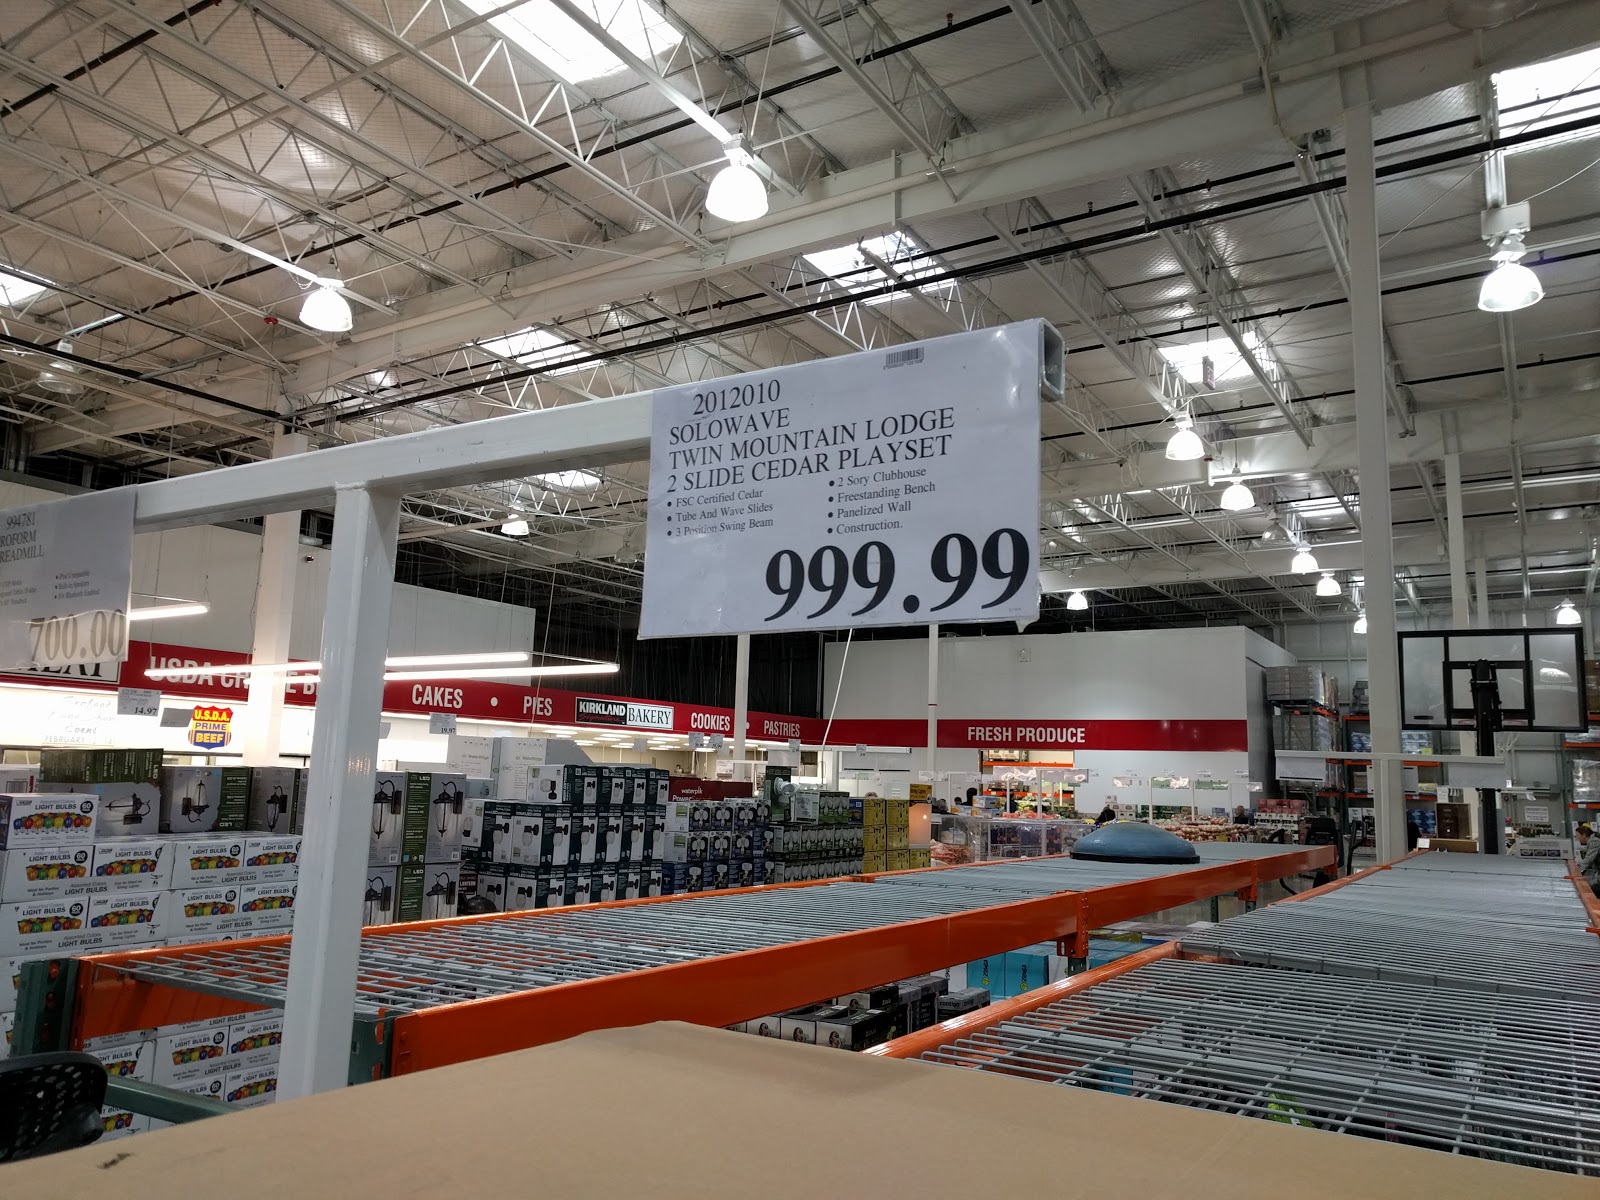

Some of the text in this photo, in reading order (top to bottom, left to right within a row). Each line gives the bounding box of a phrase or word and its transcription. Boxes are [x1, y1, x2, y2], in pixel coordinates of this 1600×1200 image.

[693, 379, 780, 415] 2012010
[669, 407, 790, 446] SOLOWAVE
[669, 407, 955, 470] TWIN MOUNTAIN LODGE
[667, 434, 952, 493] 2 SLIDE CEDAR PLAYSET
[838, 468, 927, 487] 2 Sory Clubhouse
[676, 489, 763, 507] FSC Certified Cedar
[837, 481, 936, 502] Freestanding Bench
[676, 503, 773, 522] Tube And Wave Slides
[837, 500, 911, 518] Panelized Wall
[6, 511, 36, 530] 994781
[676, 518, 774, 537] 3 Position Swing Beam
[836, 520, 903, 534] Construction.
[764, 528, 1030, 622] 999.99
[30, 609, 124, 661] 700.00
[412, 684, 463, 709] CAKES
[523, 695, 553, 716] PIES
[134, 706, 157, 716] 14.97
[579, 701, 672, 724] KIRKLAND BAKERY
[195, 722, 227, 731] PRIME
[691, 712, 730, 731] COOKIES
[764, 720, 800, 737] PASTRIES
[195, 733, 224, 743] BEEF
[968, 727, 1085, 743] FRESH PRODUCE
